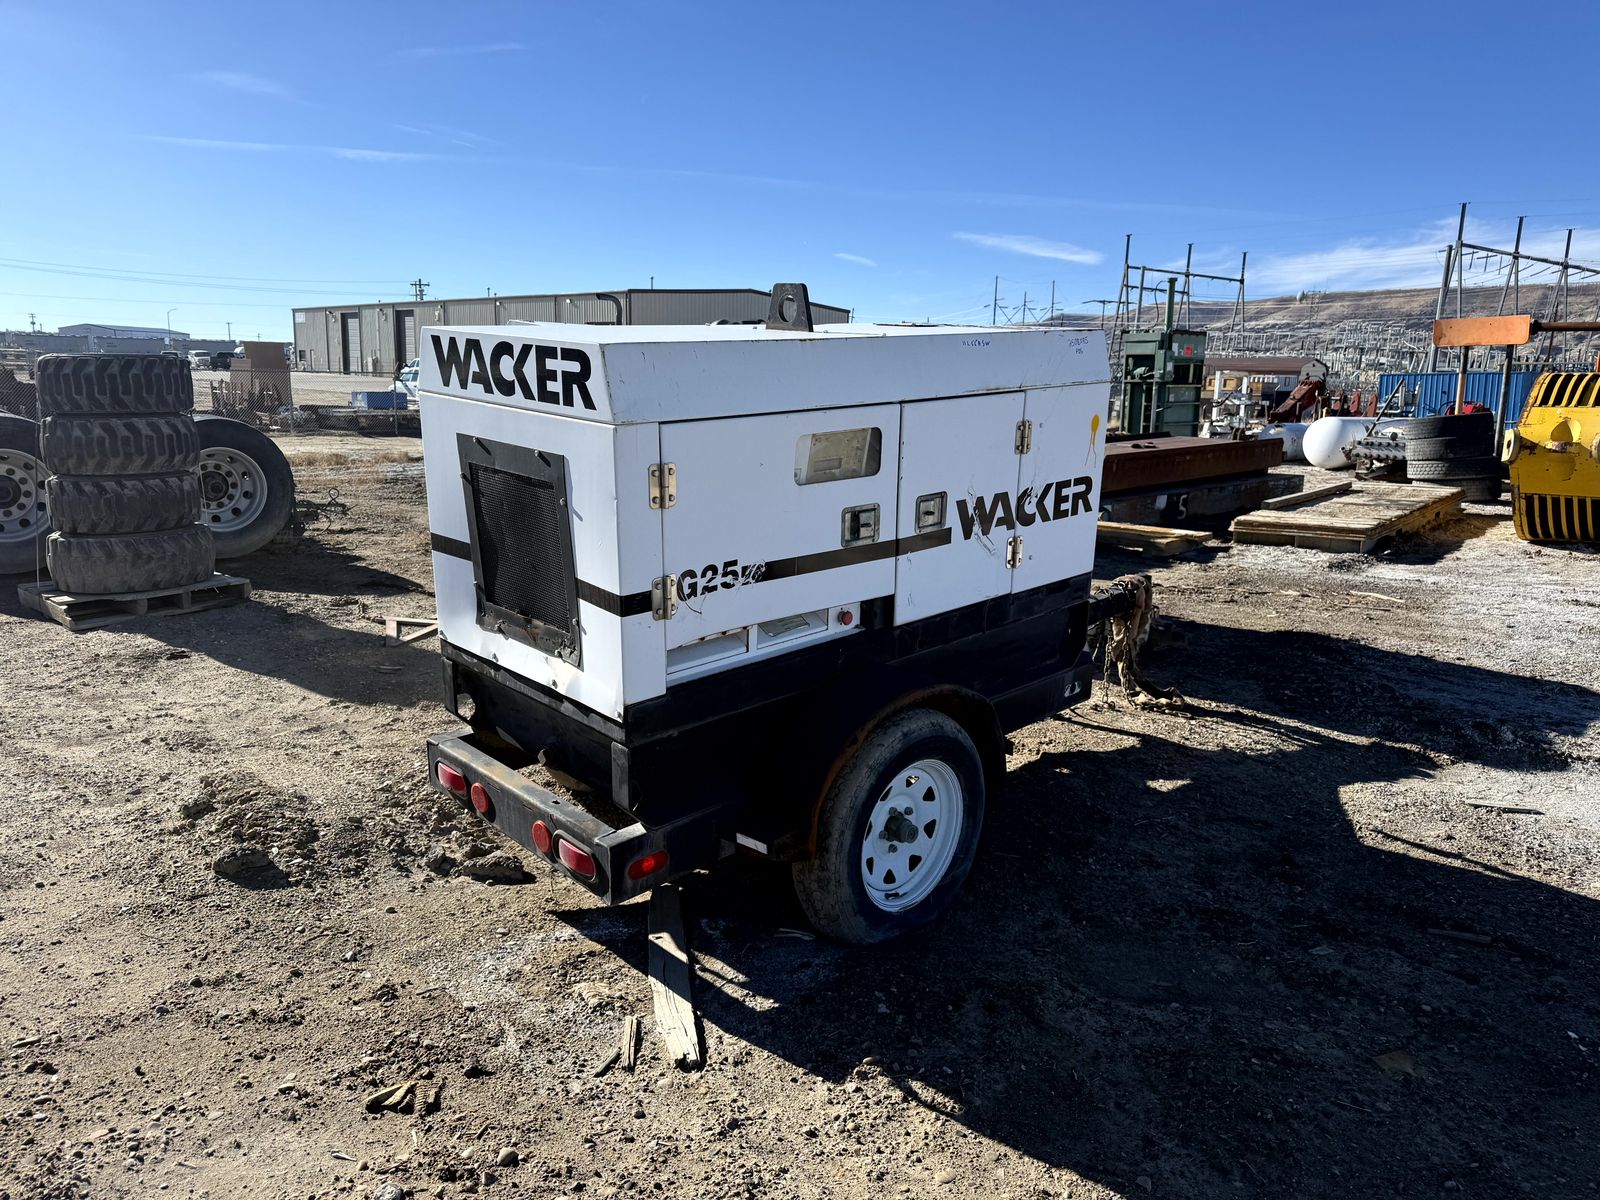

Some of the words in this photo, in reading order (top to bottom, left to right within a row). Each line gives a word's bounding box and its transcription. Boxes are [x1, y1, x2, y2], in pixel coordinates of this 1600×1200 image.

[430, 334, 597, 411] WACKER
[956, 475, 1093, 541] WACKER
[677, 559, 738, 602] G25
